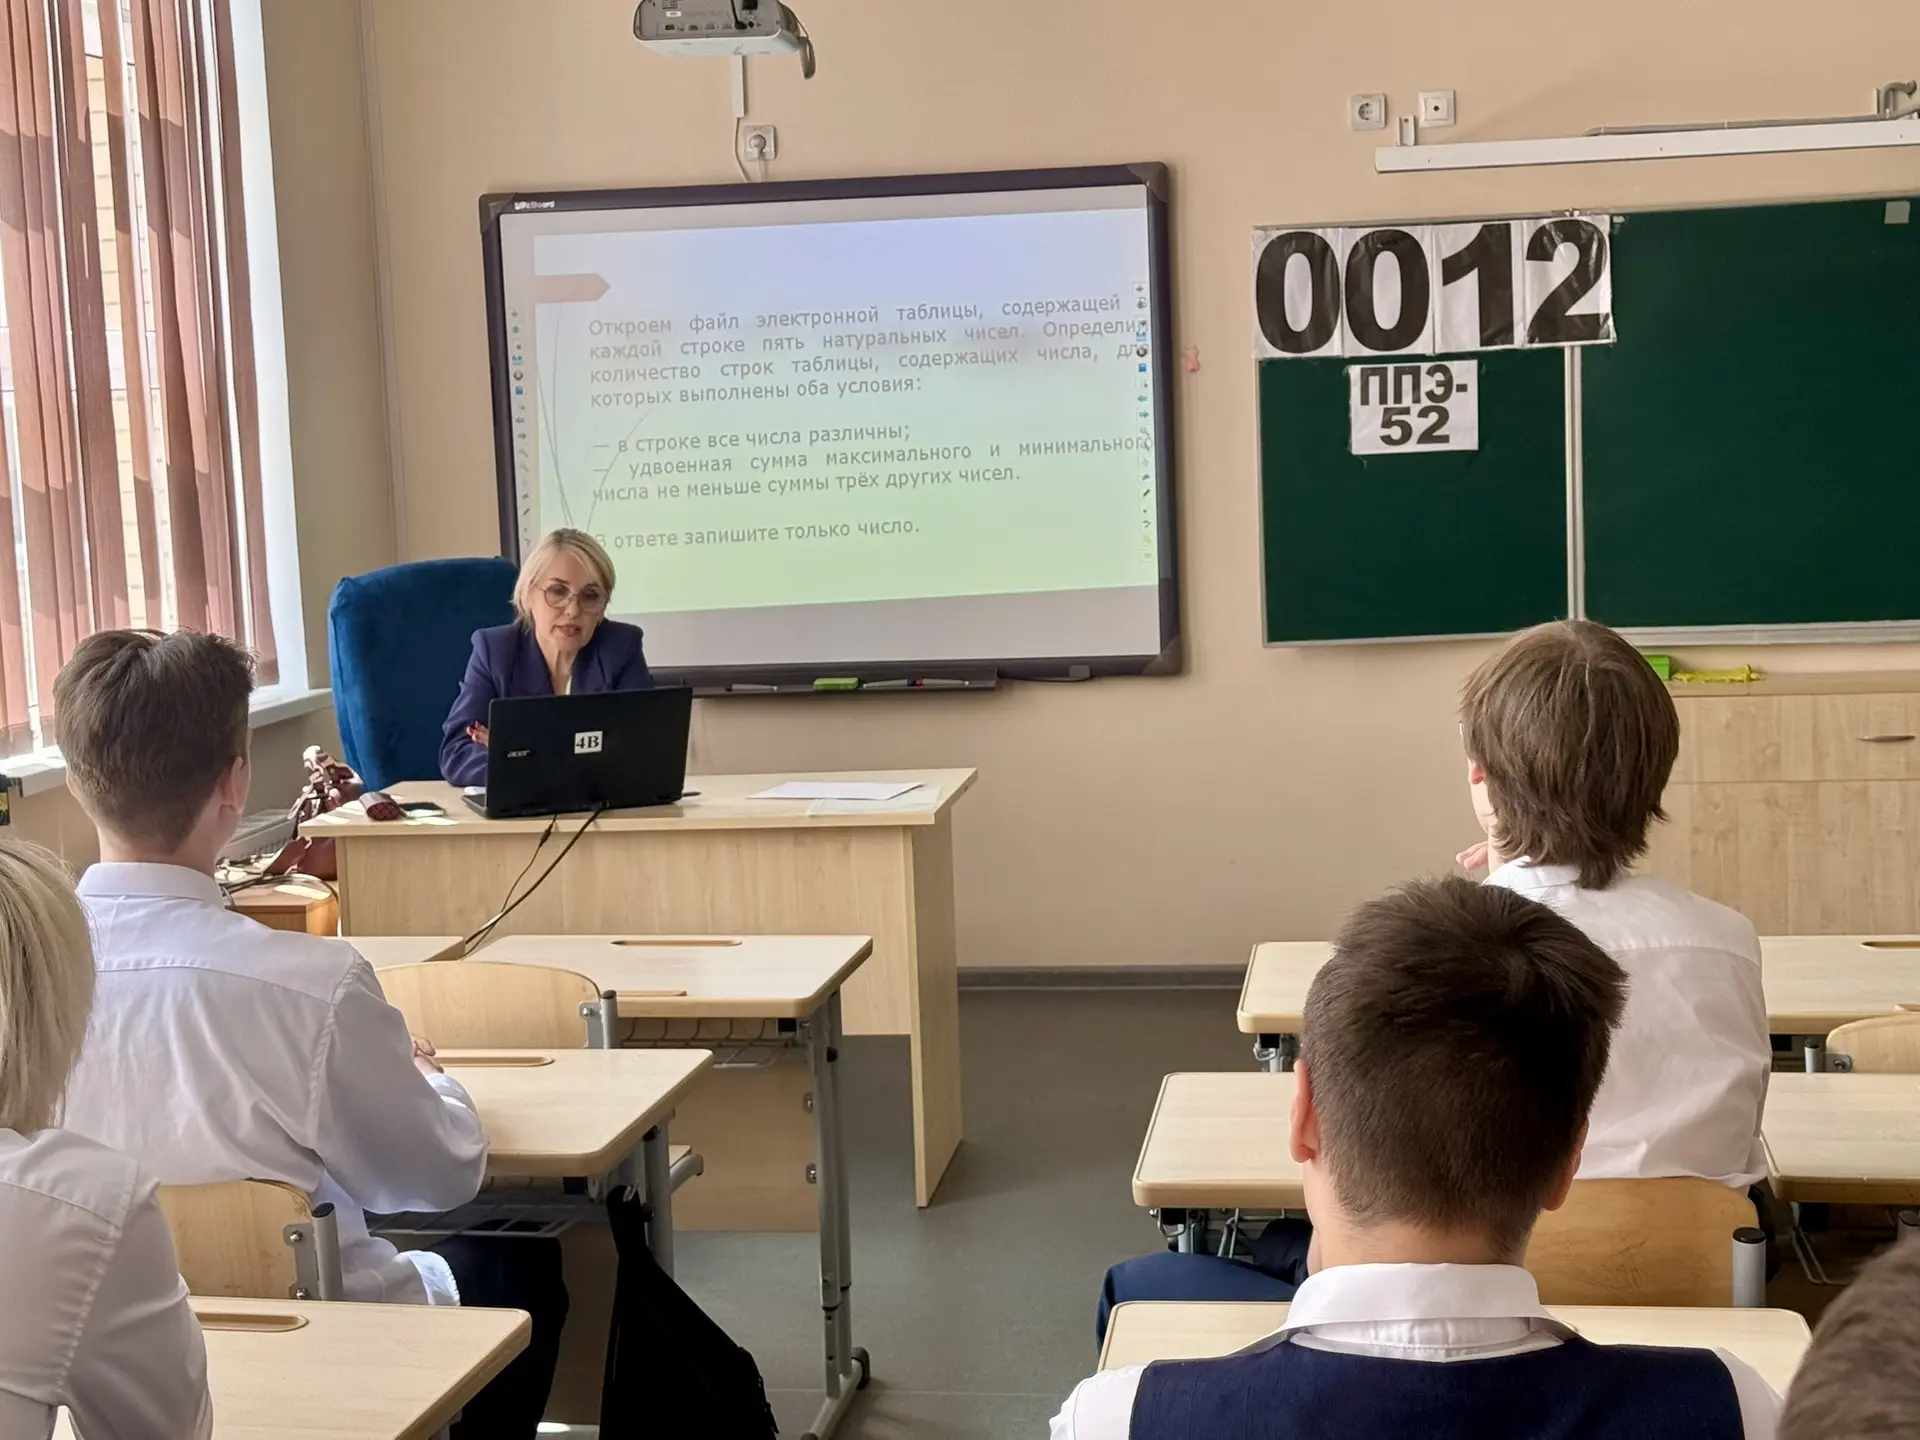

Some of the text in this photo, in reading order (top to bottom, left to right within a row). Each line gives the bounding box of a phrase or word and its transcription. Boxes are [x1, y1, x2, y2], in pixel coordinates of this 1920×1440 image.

[1256, 219, 1611, 354] 0012
[588, 318, 672, 337] Откроем
[688, 313, 740, 333] файл
[756, 305, 879, 329] электронной
[896, 303, 984, 321] таблицы,
[1002, 294, 1120, 317] содержащей
[589, 340, 662, 361] каждой
[680, 339, 746, 358] строке
[762, 336, 805, 352] пять
[822, 328, 947, 352] натуральных
[965, 325, 1026, 341] чисел.
[590, 365, 702, 384] количество
[720, 361, 775, 381] строк
[791, 356, 880, 377] таблицы,
[898, 348, 1019, 371] содержащих
[1036, 345, 1099, 362] числа,
[591, 375, 922, 409] которых выполнены оба условия:
[1360, 364, 1468, 406] ППЭ-
[618, 439, 629, 453] в
[635, 433, 702, 455] строке
[707, 433, 740, 449] все
[746, 429, 802, 446] числа
[809, 424, 910, 446] различны;
[1380, 405, 1450, 446] 52
[629, 458, 733, 480] удвоенная
[750, 453, 809, 473] сумма
[825, 443, 972, 466] максимального
[989, 444, 1001, 458] и
[1018, 434, 1152, 455] минимального
[592, 466, 1021, 502] числа не меньше суммы трёх других чисел.
[614, 532, 679, 549] ответе
[684, 526, 780, 546] запишите
[784, 522, 851, 541] только
[857, 519, 921, 538] число.
